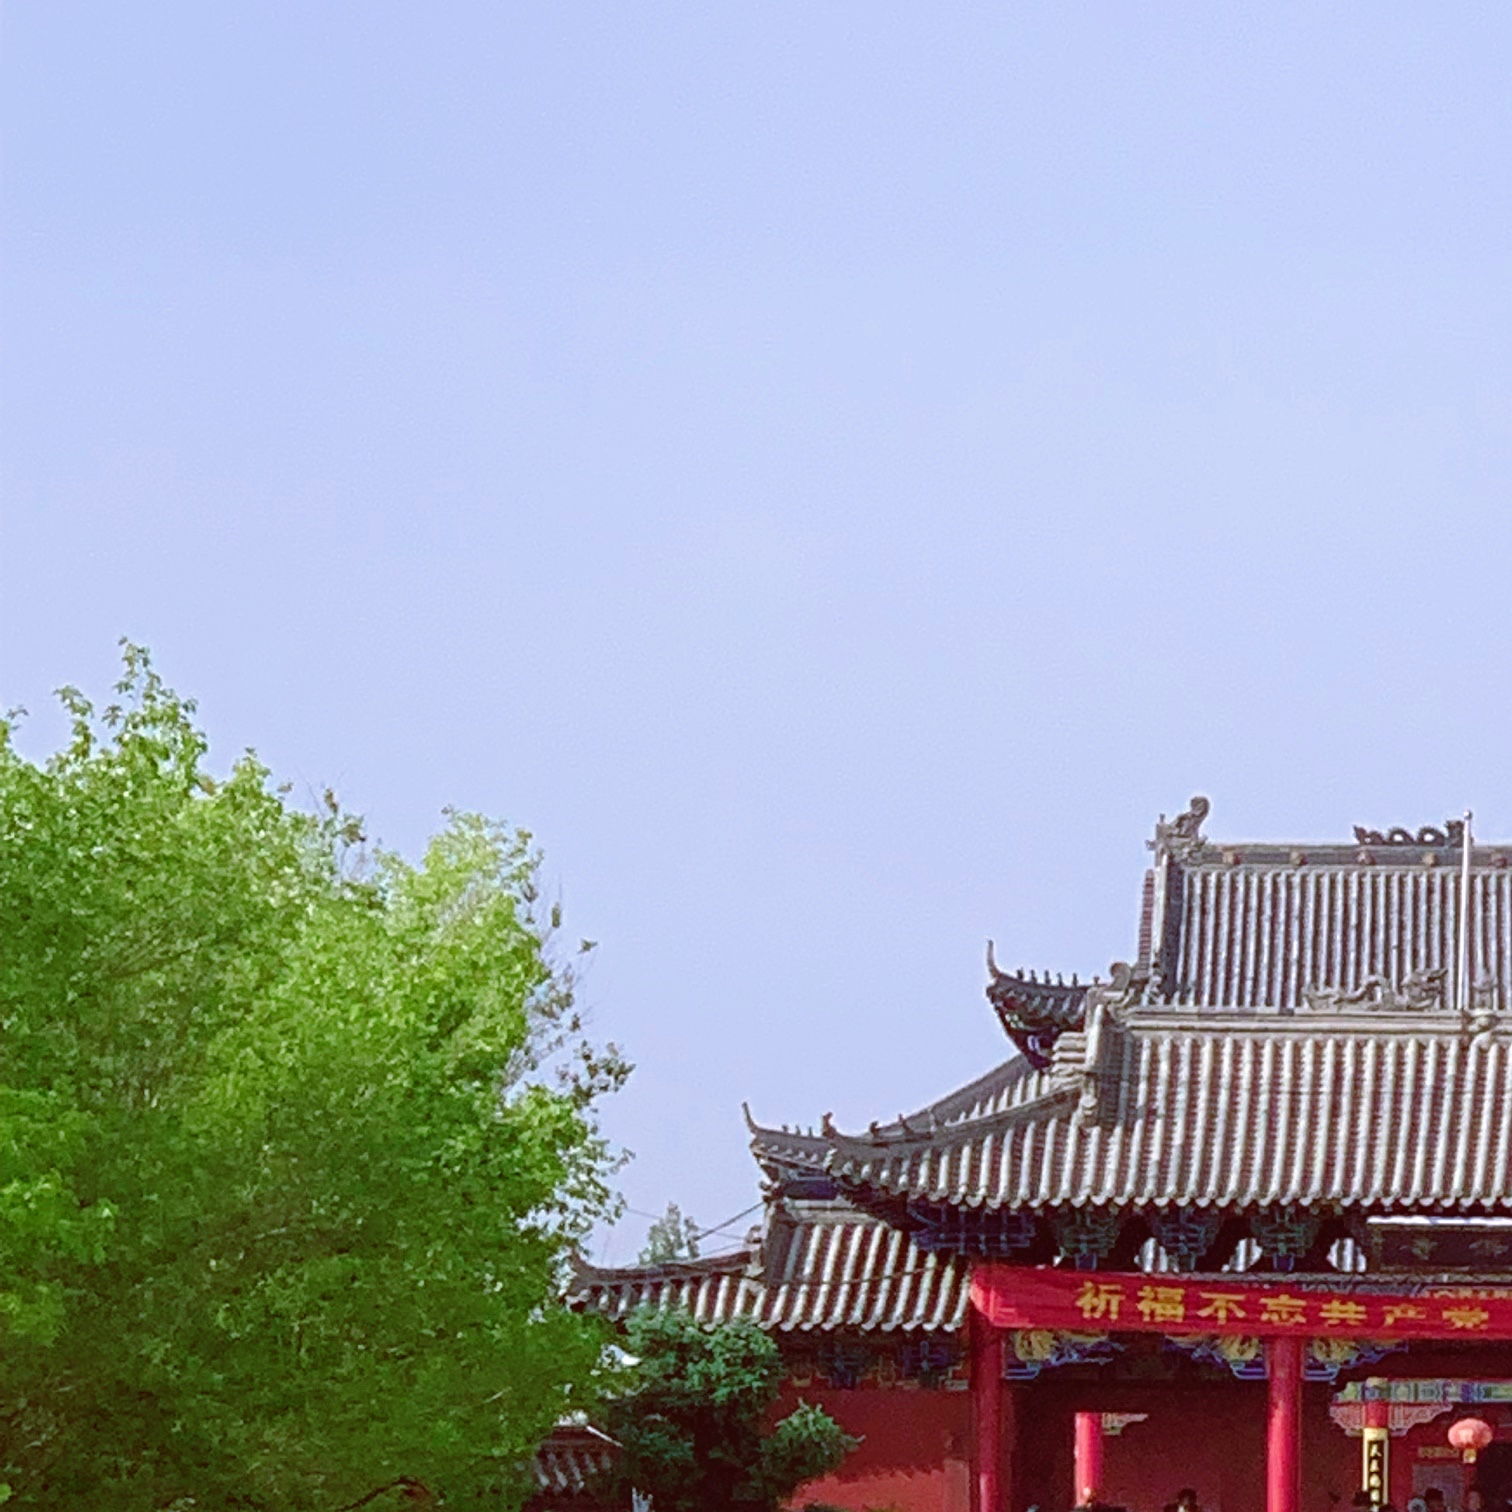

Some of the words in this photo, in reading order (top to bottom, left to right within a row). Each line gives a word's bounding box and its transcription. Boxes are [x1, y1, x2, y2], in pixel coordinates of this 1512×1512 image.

[1075, 1281, 1490, 1328] 祈福不忘共产党
